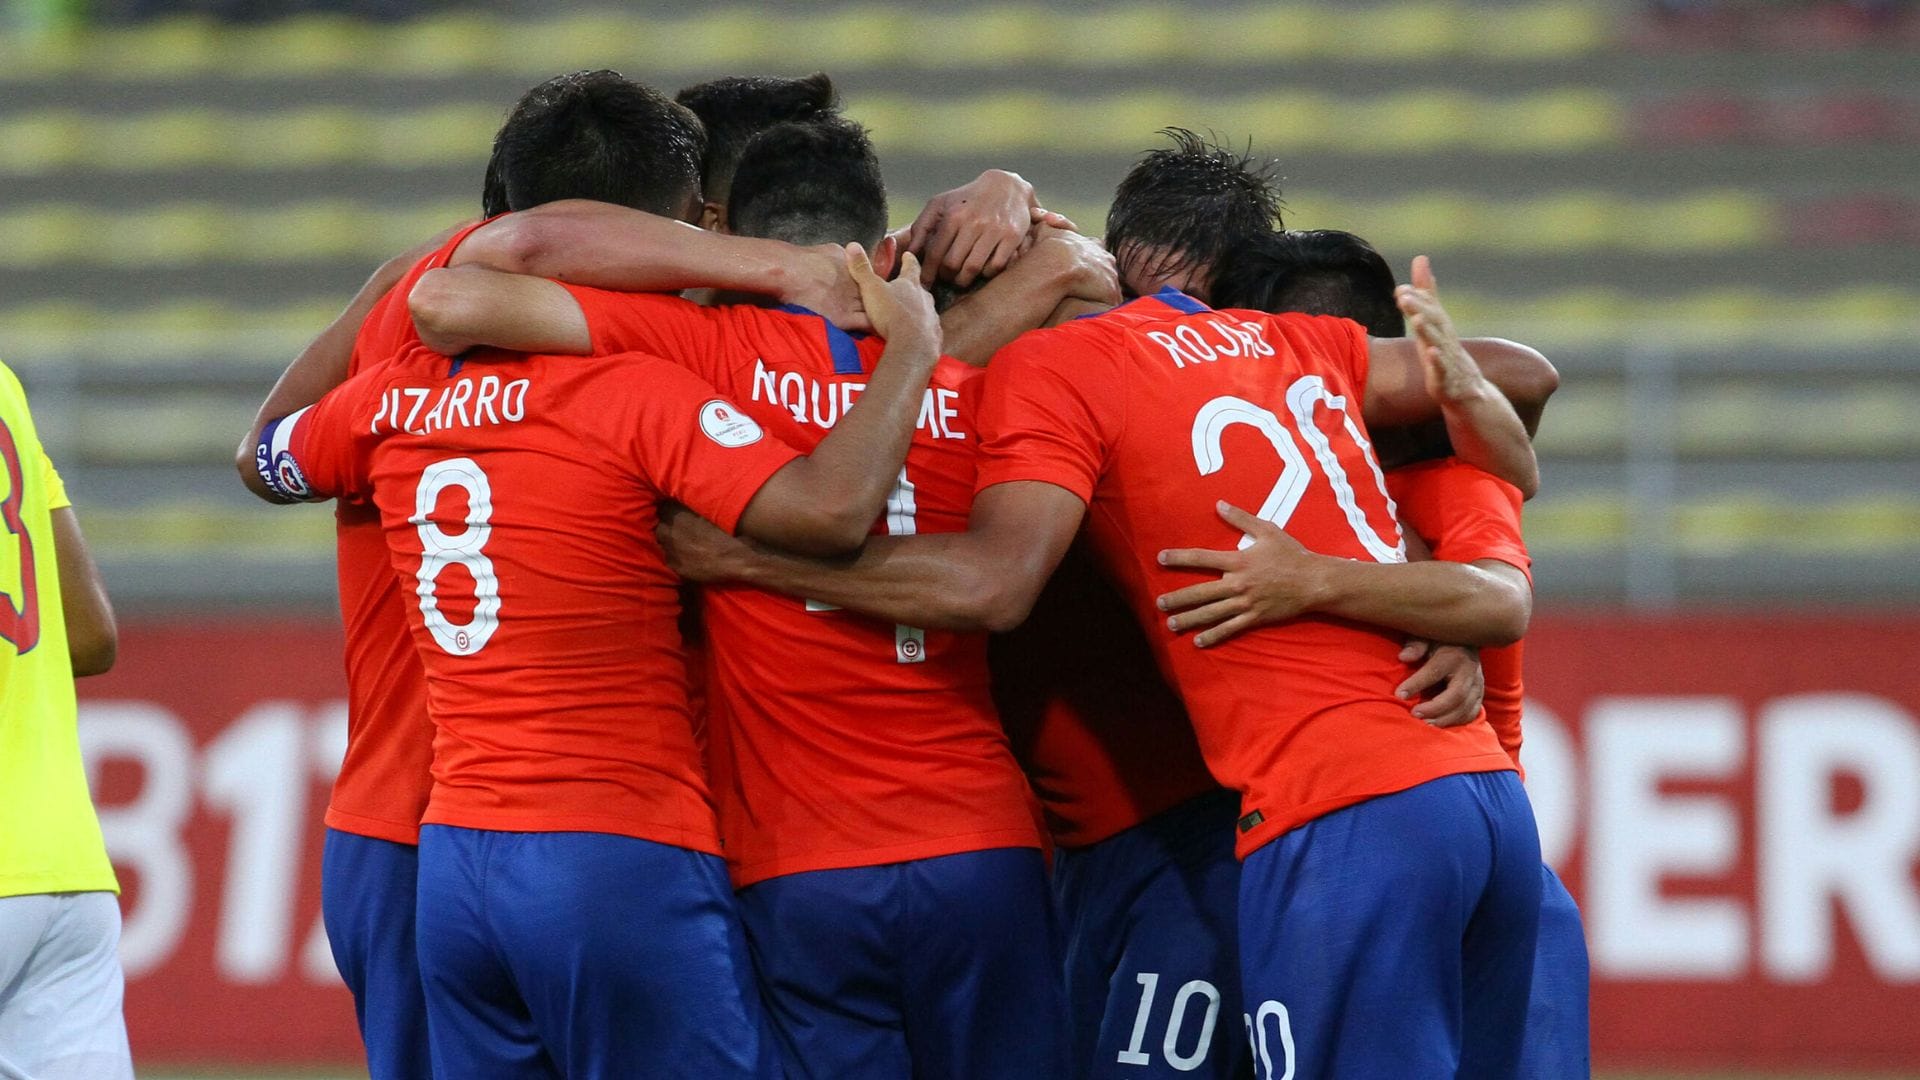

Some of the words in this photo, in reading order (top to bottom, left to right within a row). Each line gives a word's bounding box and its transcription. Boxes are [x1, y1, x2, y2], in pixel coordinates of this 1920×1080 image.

[1147, 320, 1275, 368] ROJAS
[1191, 375, 1407, 563] 20
[408, 457, 500, 656] 8
[1117, 972, 1221, 1071] 10
